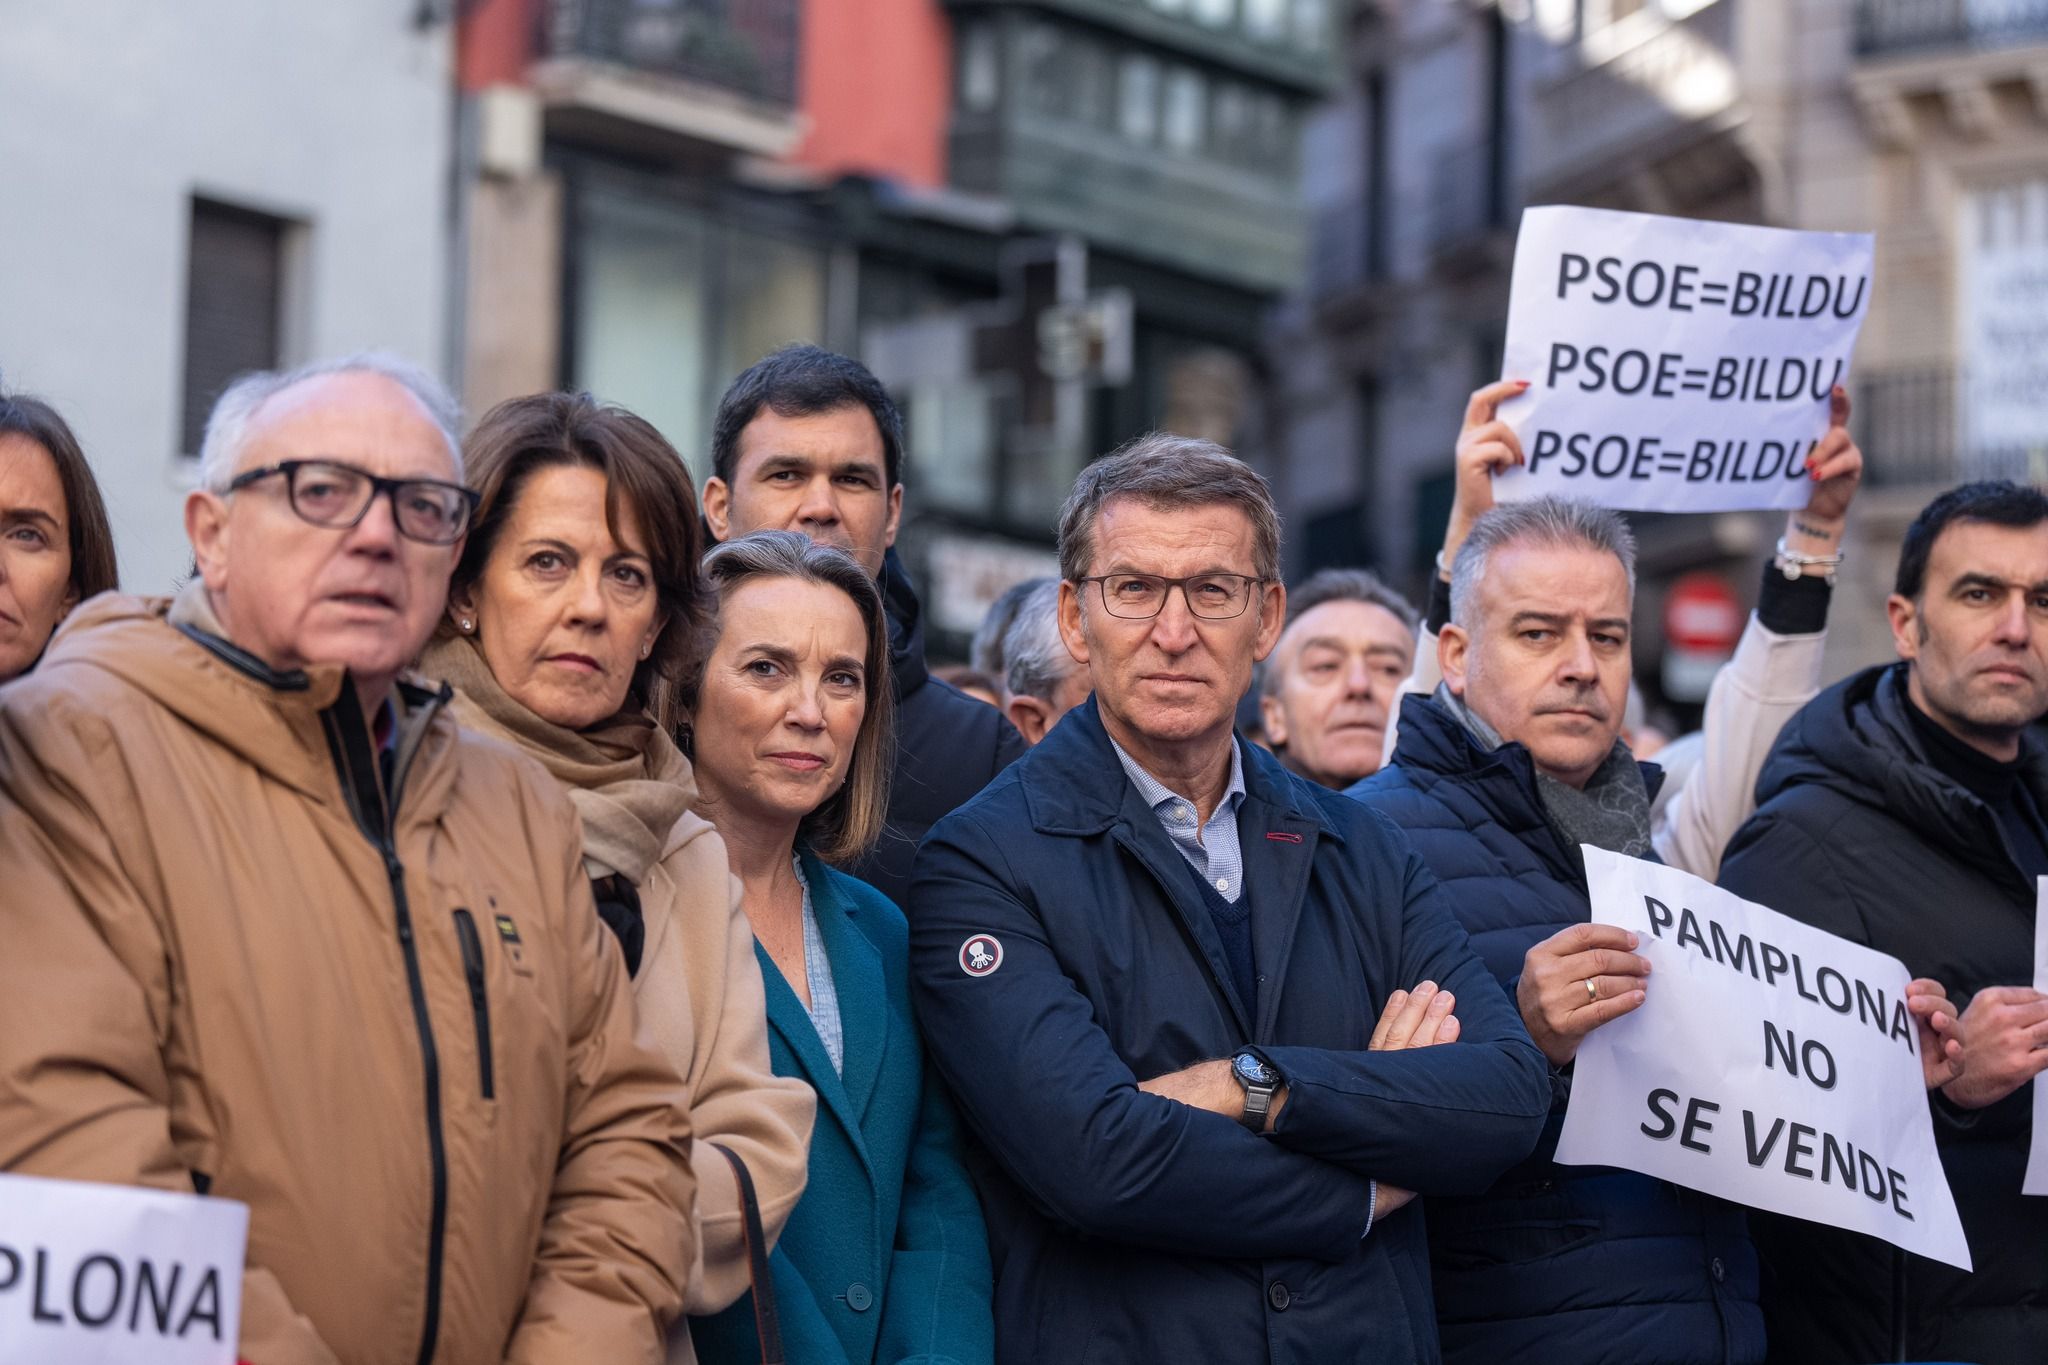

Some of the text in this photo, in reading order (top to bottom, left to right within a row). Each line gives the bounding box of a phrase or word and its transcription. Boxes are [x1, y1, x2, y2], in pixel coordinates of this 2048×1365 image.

[1558, 253, 1866, 320] PSOE=BILDU
[1547, 343, 1842, 401] PSOE=BILDU
[1529, 430, 1819, 482] PSOE=BILDU
[1643, 895, 1915, 1055] PAMPLONA
[1763, 1020, 1837, 1090] NO
[1640, 1088, 1915, 1222] SE VENDE
